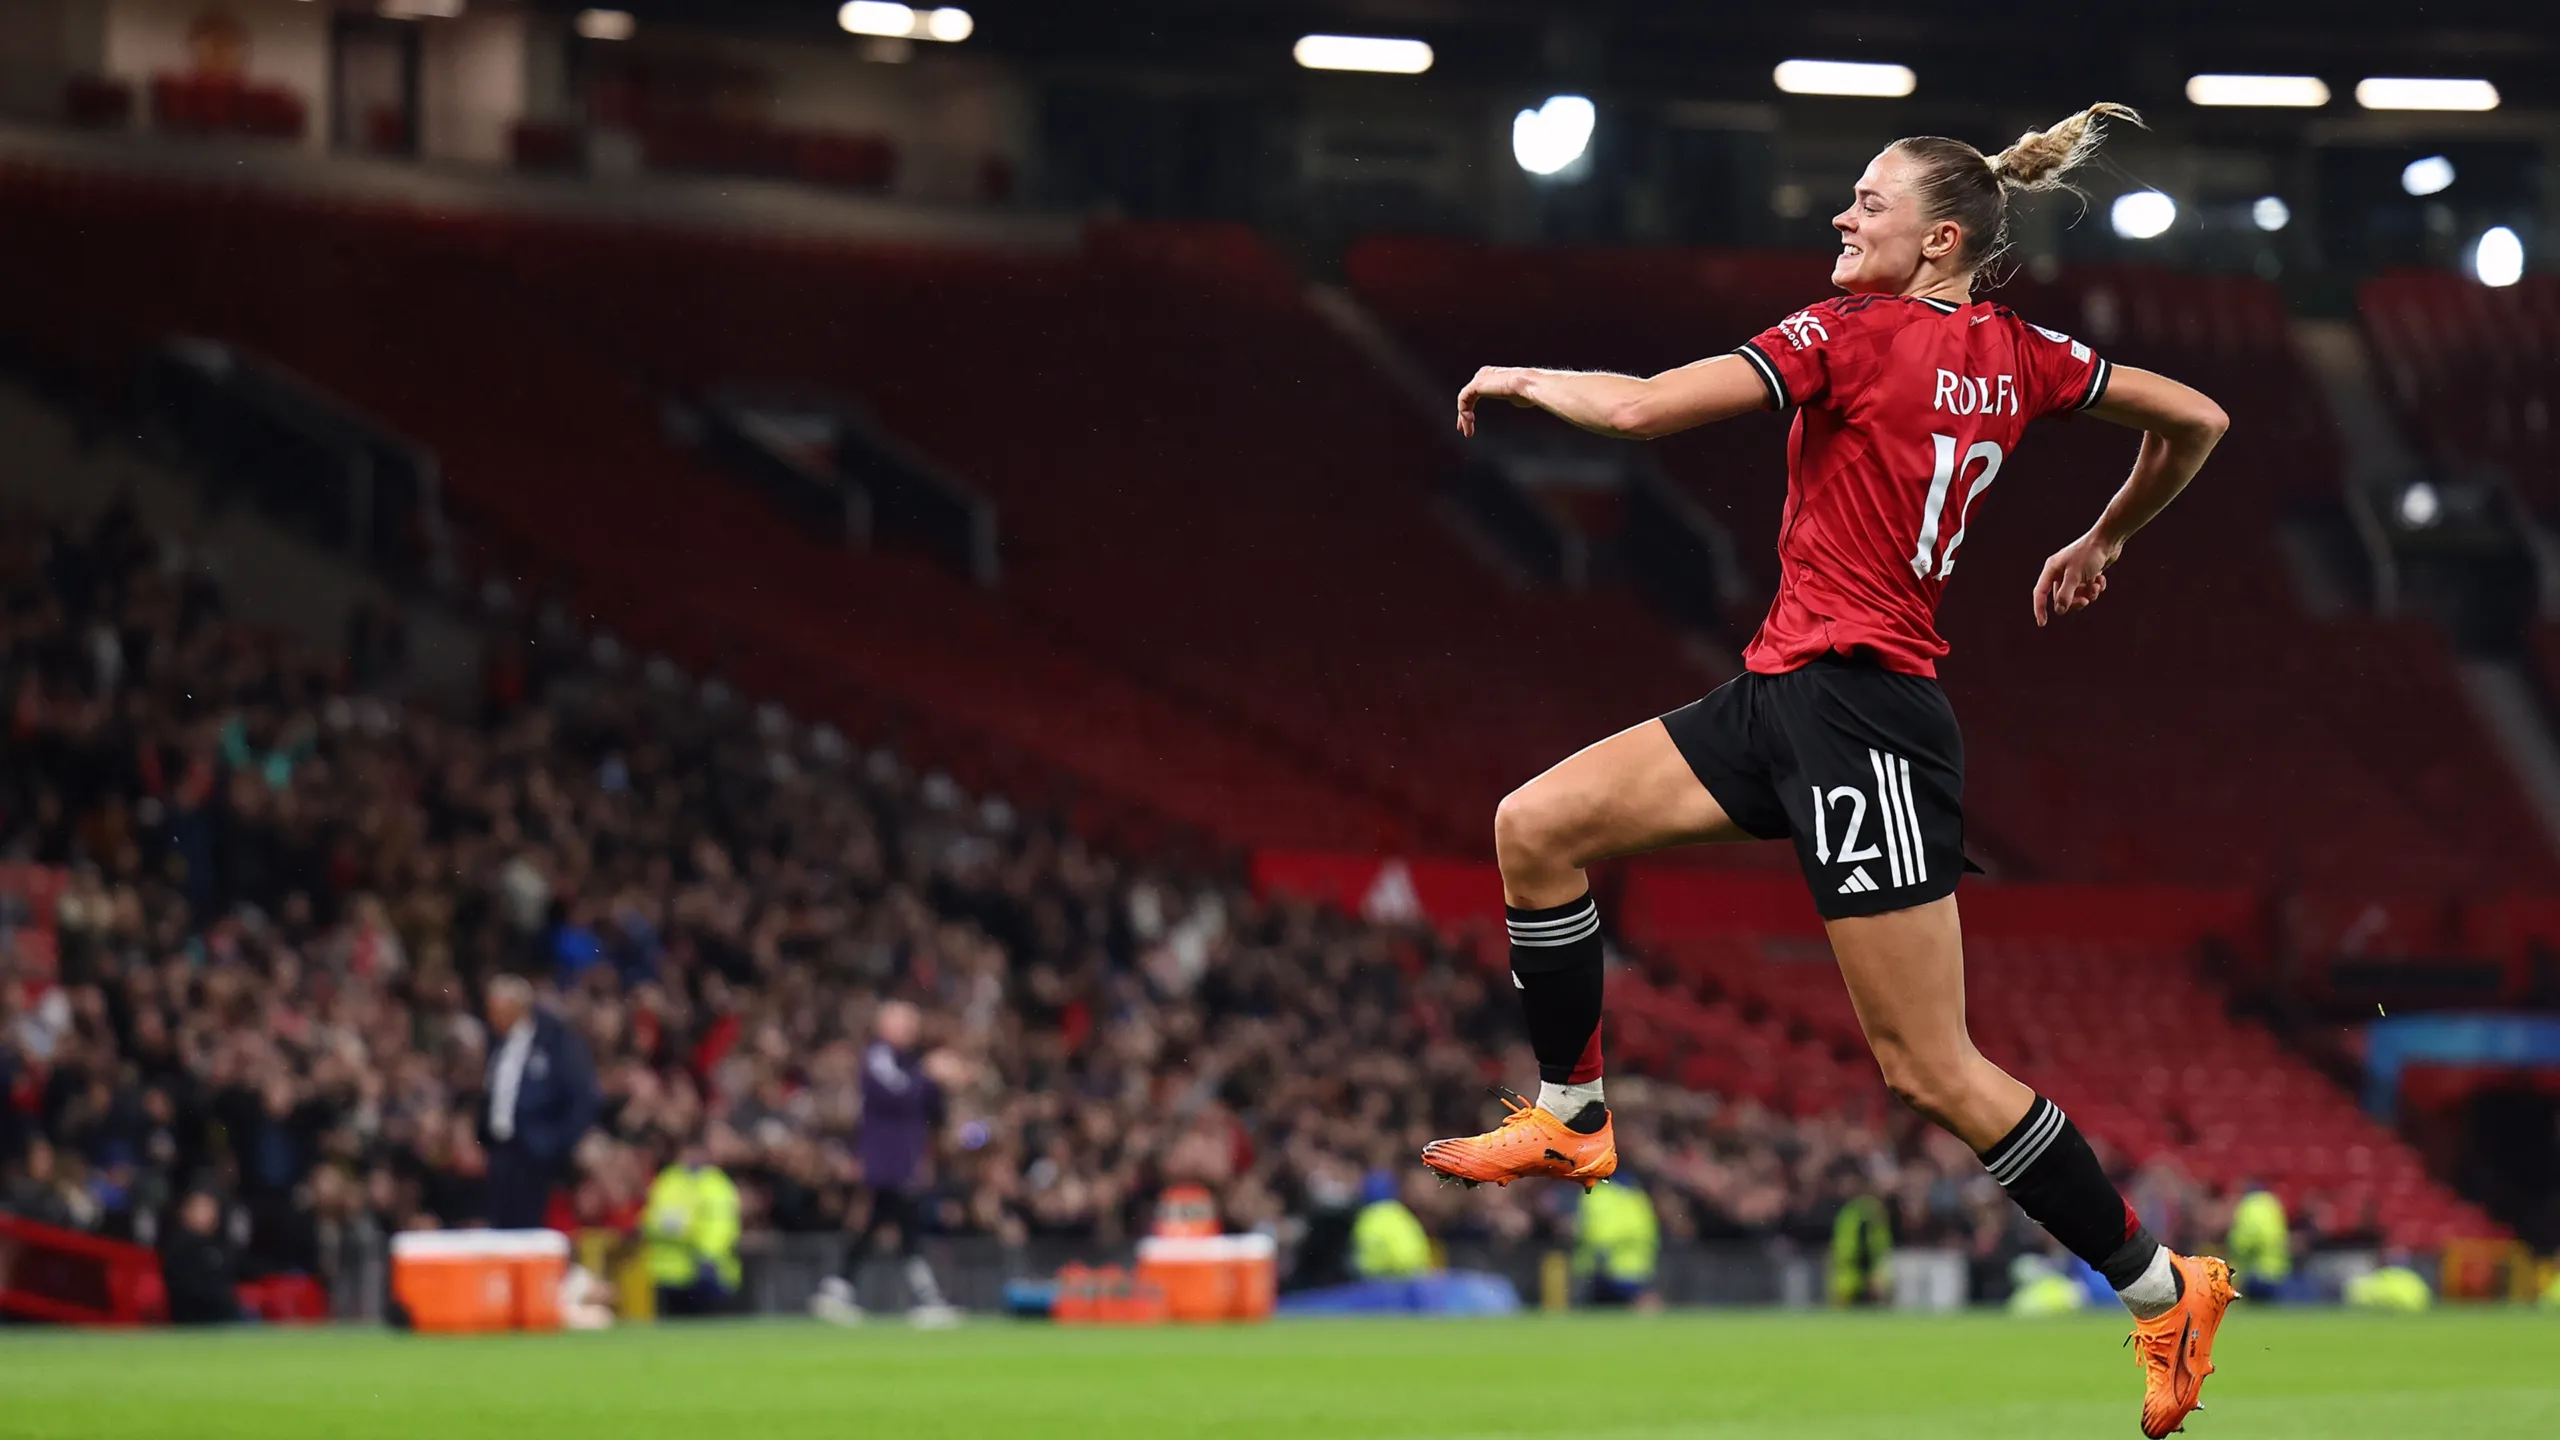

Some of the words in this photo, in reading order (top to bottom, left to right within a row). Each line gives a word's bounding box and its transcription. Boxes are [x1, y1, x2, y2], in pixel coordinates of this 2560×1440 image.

[1785, 310, 1829, 347] XC
[1909, 432, 2003, 582] 12
[1811, 785, 1882, 866] 12
